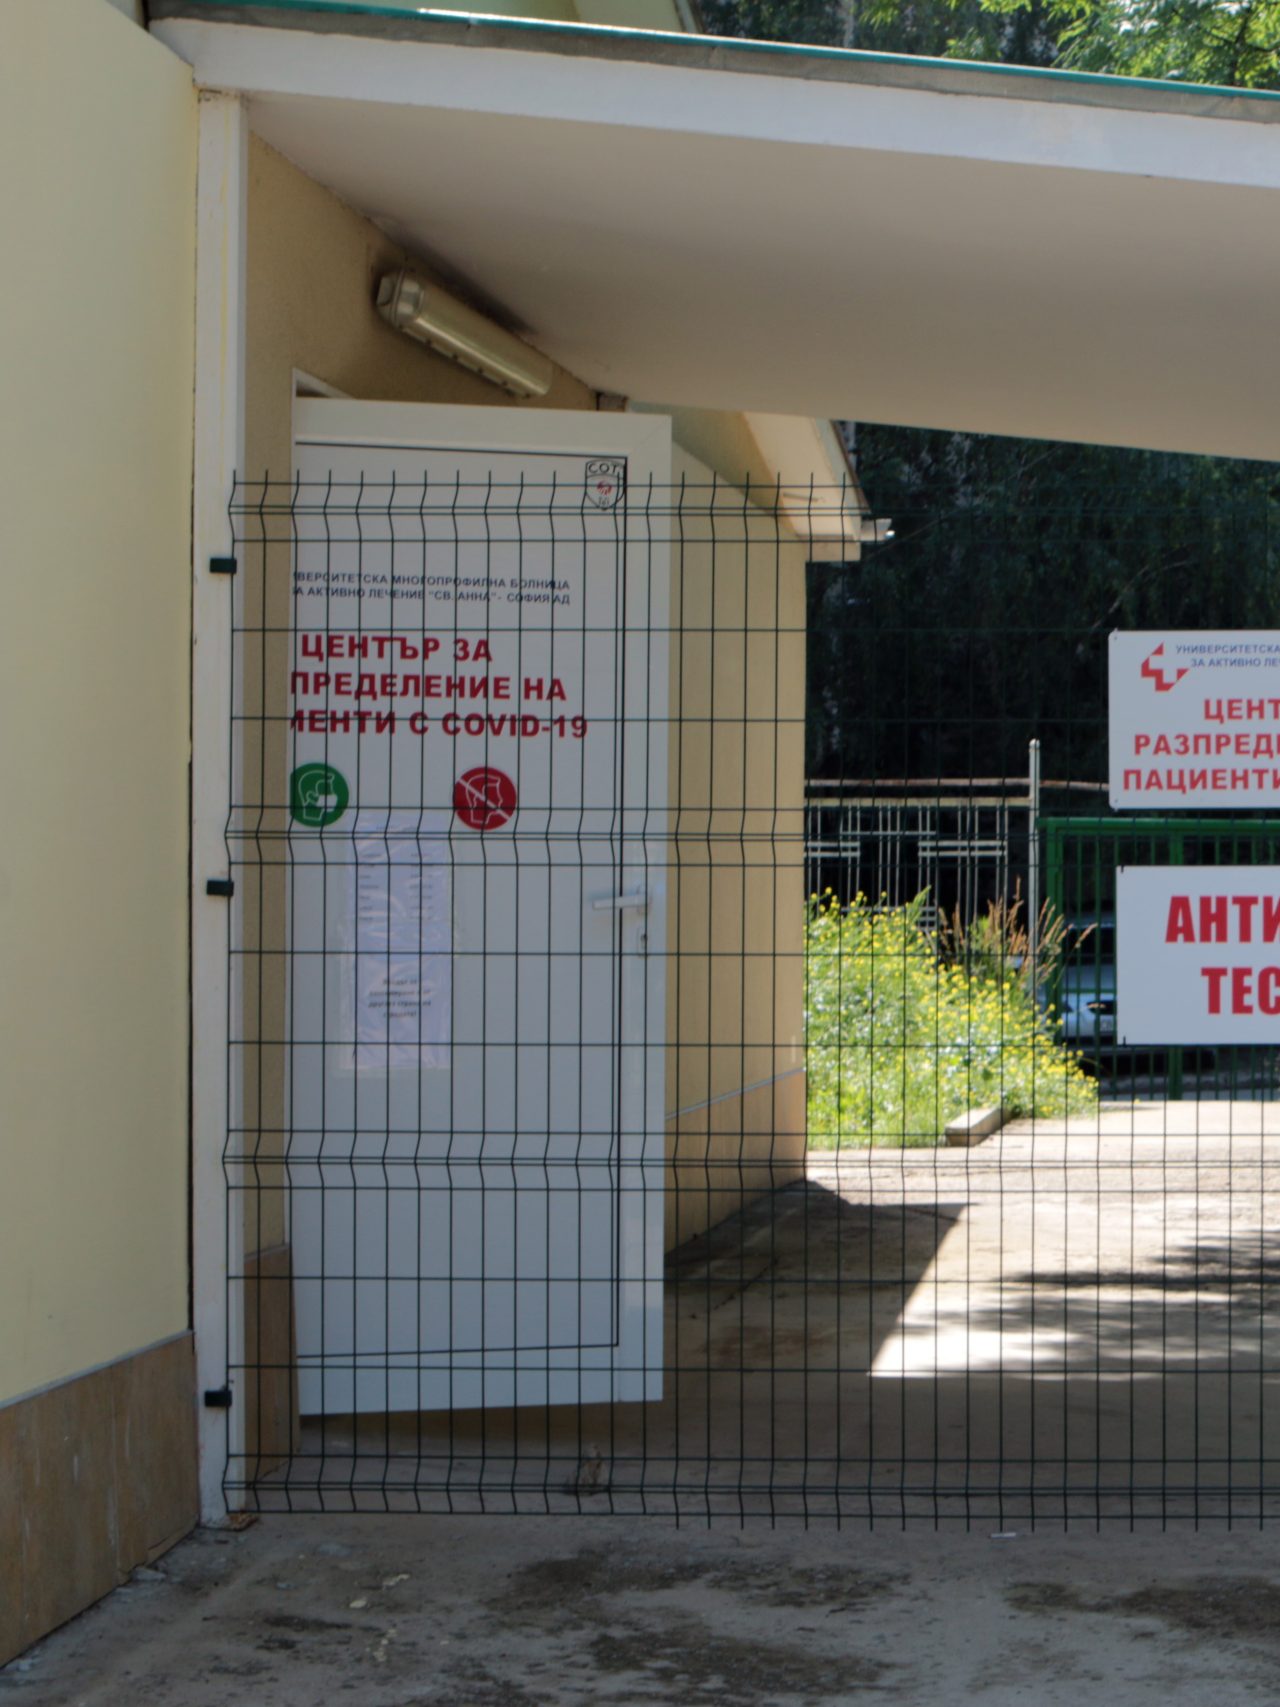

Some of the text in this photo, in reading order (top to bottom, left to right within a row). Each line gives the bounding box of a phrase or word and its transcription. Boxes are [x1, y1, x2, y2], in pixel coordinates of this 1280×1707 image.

[293, 571, 388, 584] ВЕРСИТЕСКА
[506, 592, 550, 603] СОФИЯ
[551, 593, 570, 605] АД
[301, 634, 493, 662] ЦЕНТЪР ЗА
[1191, 657, 1206, 667] ЗА
[1208, 657, 1261, 667] АКТИВНО
[523, 677, 567, 702] НА
[409, 711, 429, 735] С
[442, 712, 588, 738] COVID-19
